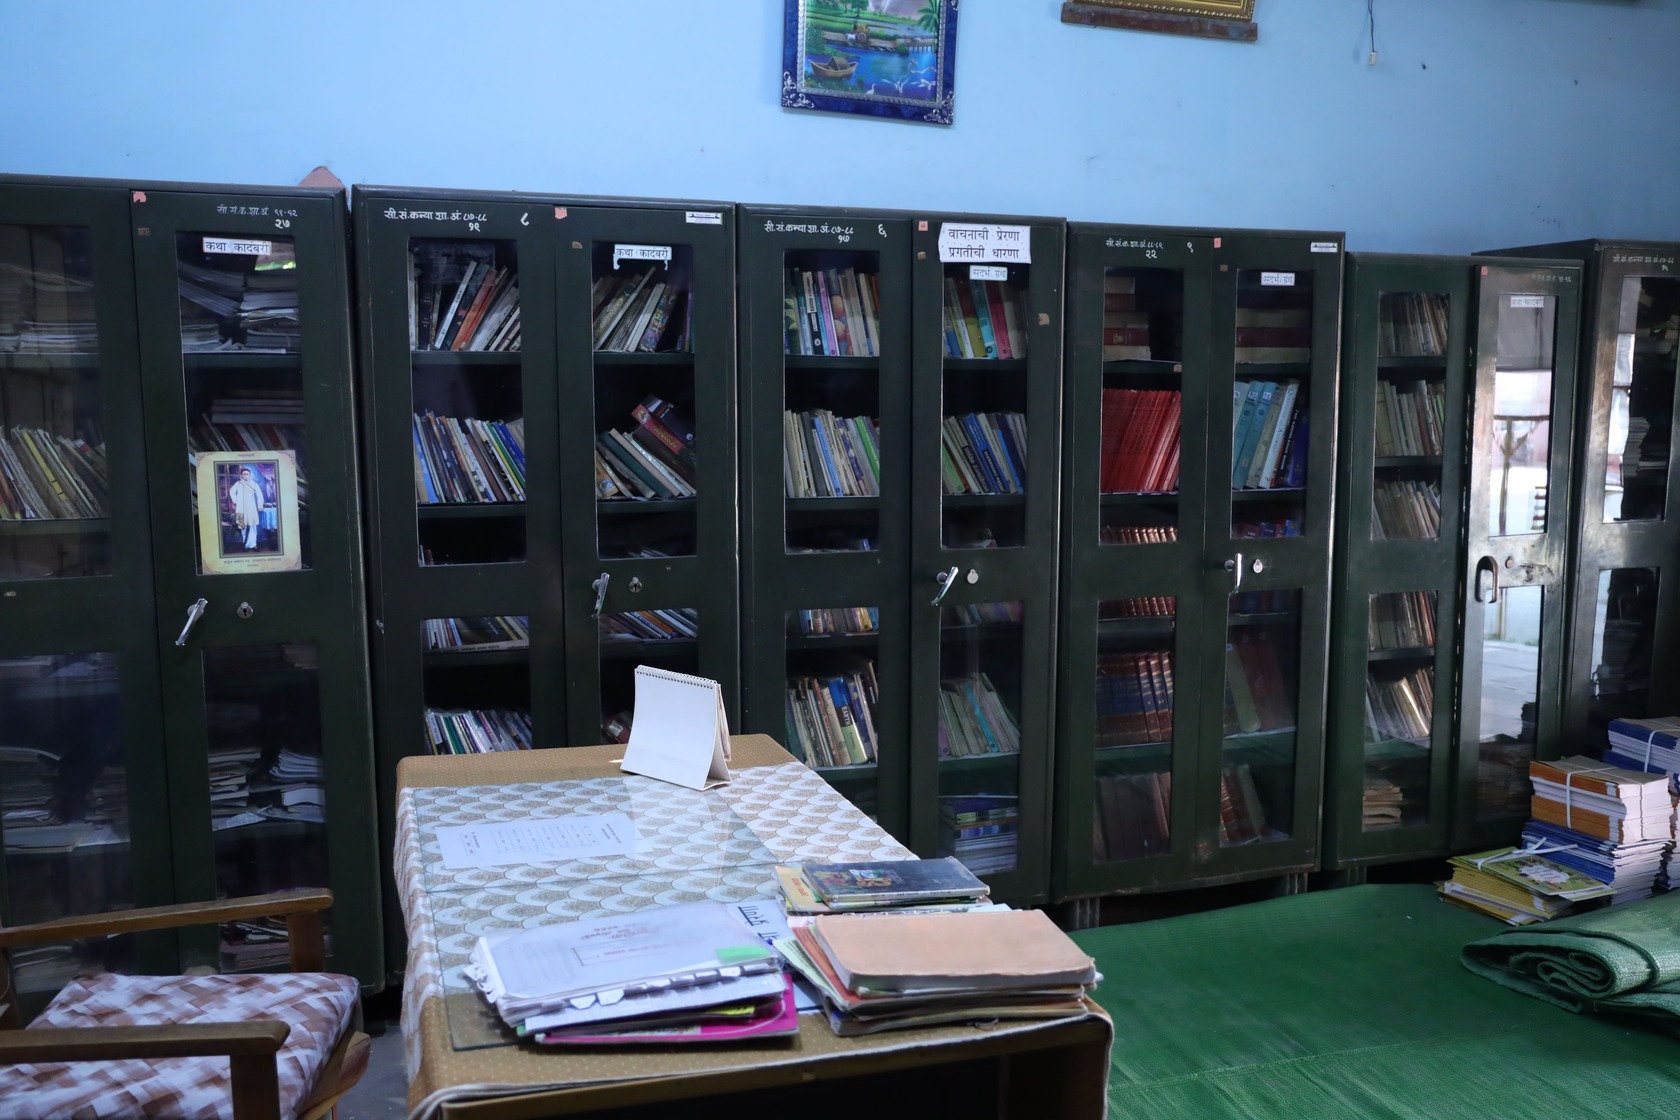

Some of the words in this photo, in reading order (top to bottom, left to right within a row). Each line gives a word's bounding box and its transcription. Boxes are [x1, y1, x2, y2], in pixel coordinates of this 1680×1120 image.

[274, 218, 291, 229] २७
[948, 226, 989, 240] वाचनाची
[996, 226, 1020, 241] प्रेरणा
[205, 240, 226, 252] कथा
[234, 240, 269, 254] कादंबरी
[616, 247, 633, 257] कथा
[639, 247, 669, 259] कादंबरी
[948, 244, 985, 258] प्रगतीची
[992, 248, 1020, 259] धारणा
[1145, 249, 1158, 259] २२
[841, 705, 852, 726] EARTH
